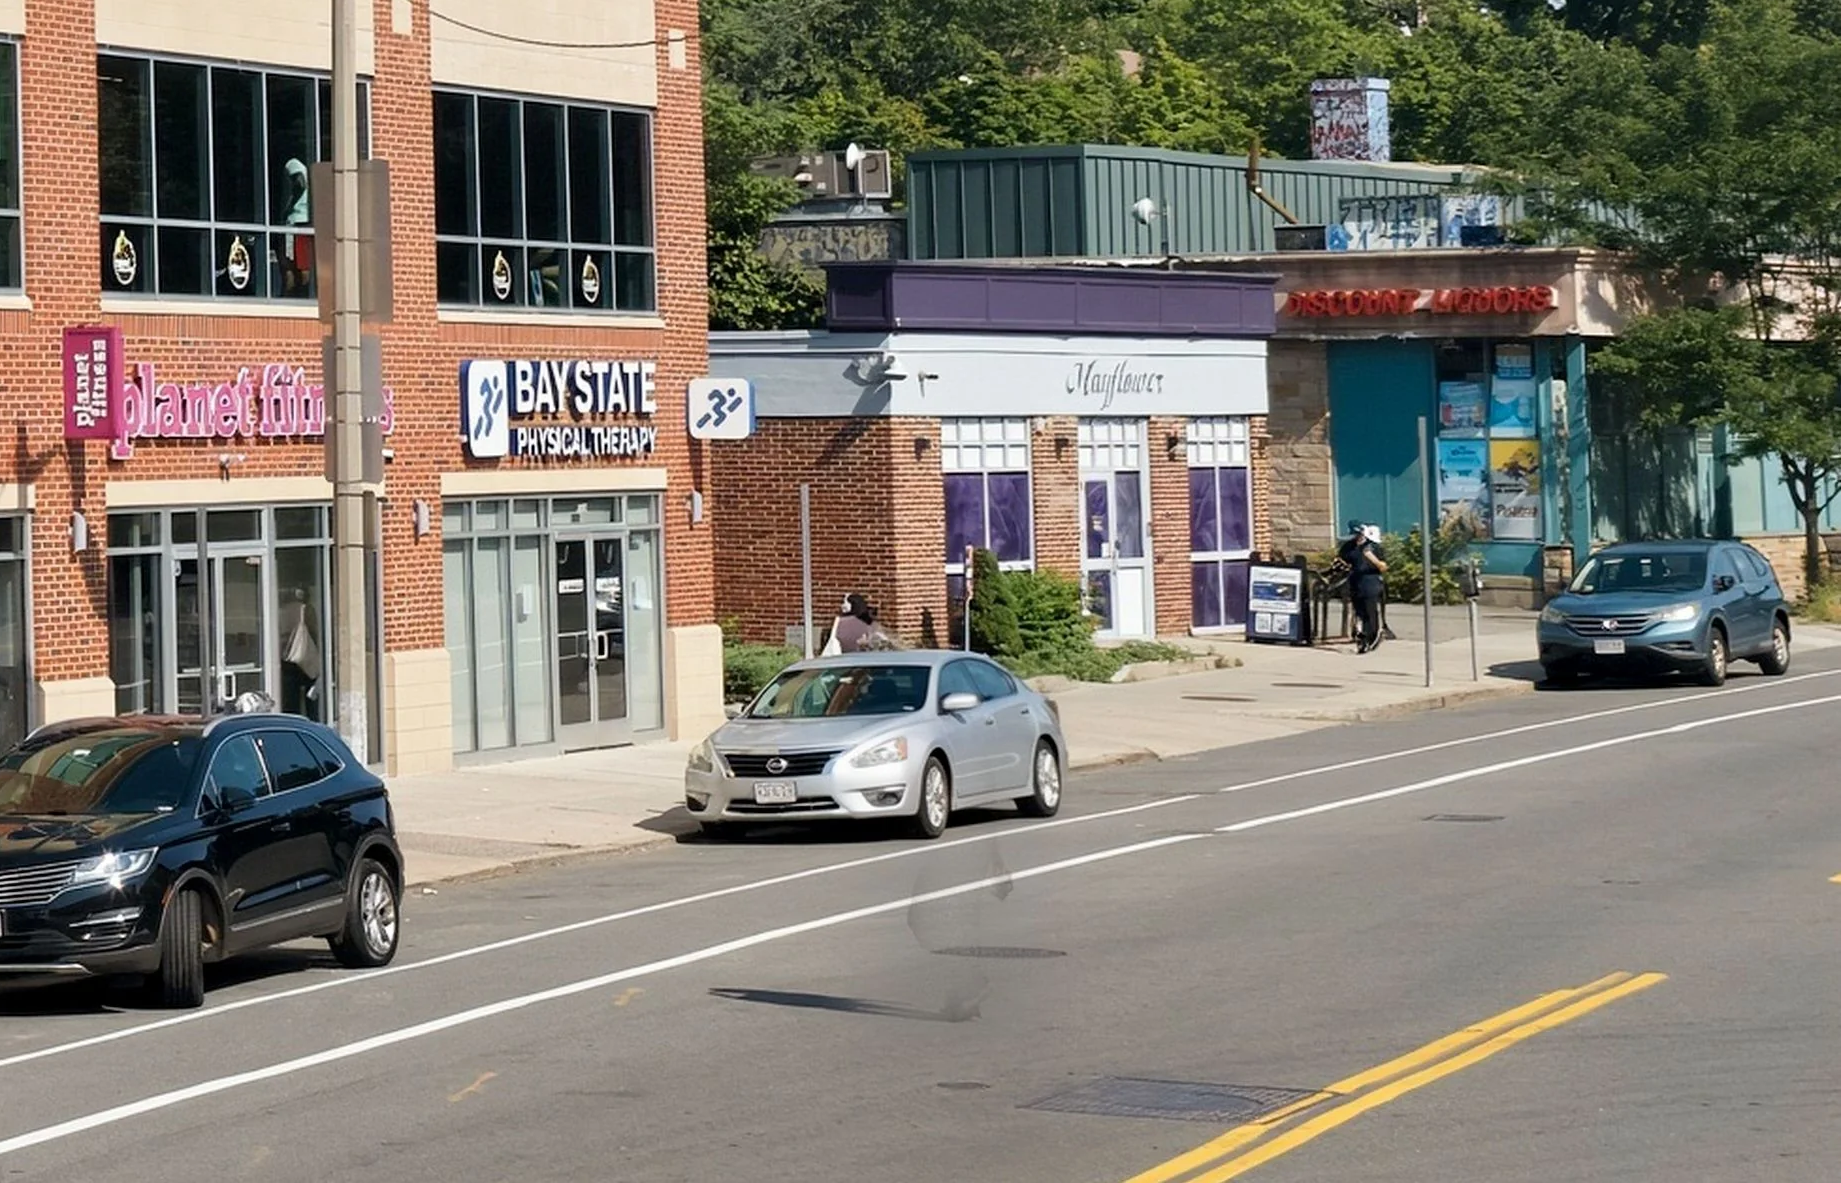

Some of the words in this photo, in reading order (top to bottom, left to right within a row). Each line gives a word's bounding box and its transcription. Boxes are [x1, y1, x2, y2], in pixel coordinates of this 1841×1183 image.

[1286, 290, 1419, 315] DISCOUNT
[1430, 285, 1552, 314] LIQUORS
[72, 352, 95, 427] planet
[111, 362, 256, 460] planet
[515, 360, 572, 413] BAY
[575, 360, 657, 413] STATE
[1065, 359, 1164, 411] Mayflower
[517, 426, 592, 457] PHYSICAL
[591, 426, 658, 456] THERAPY
